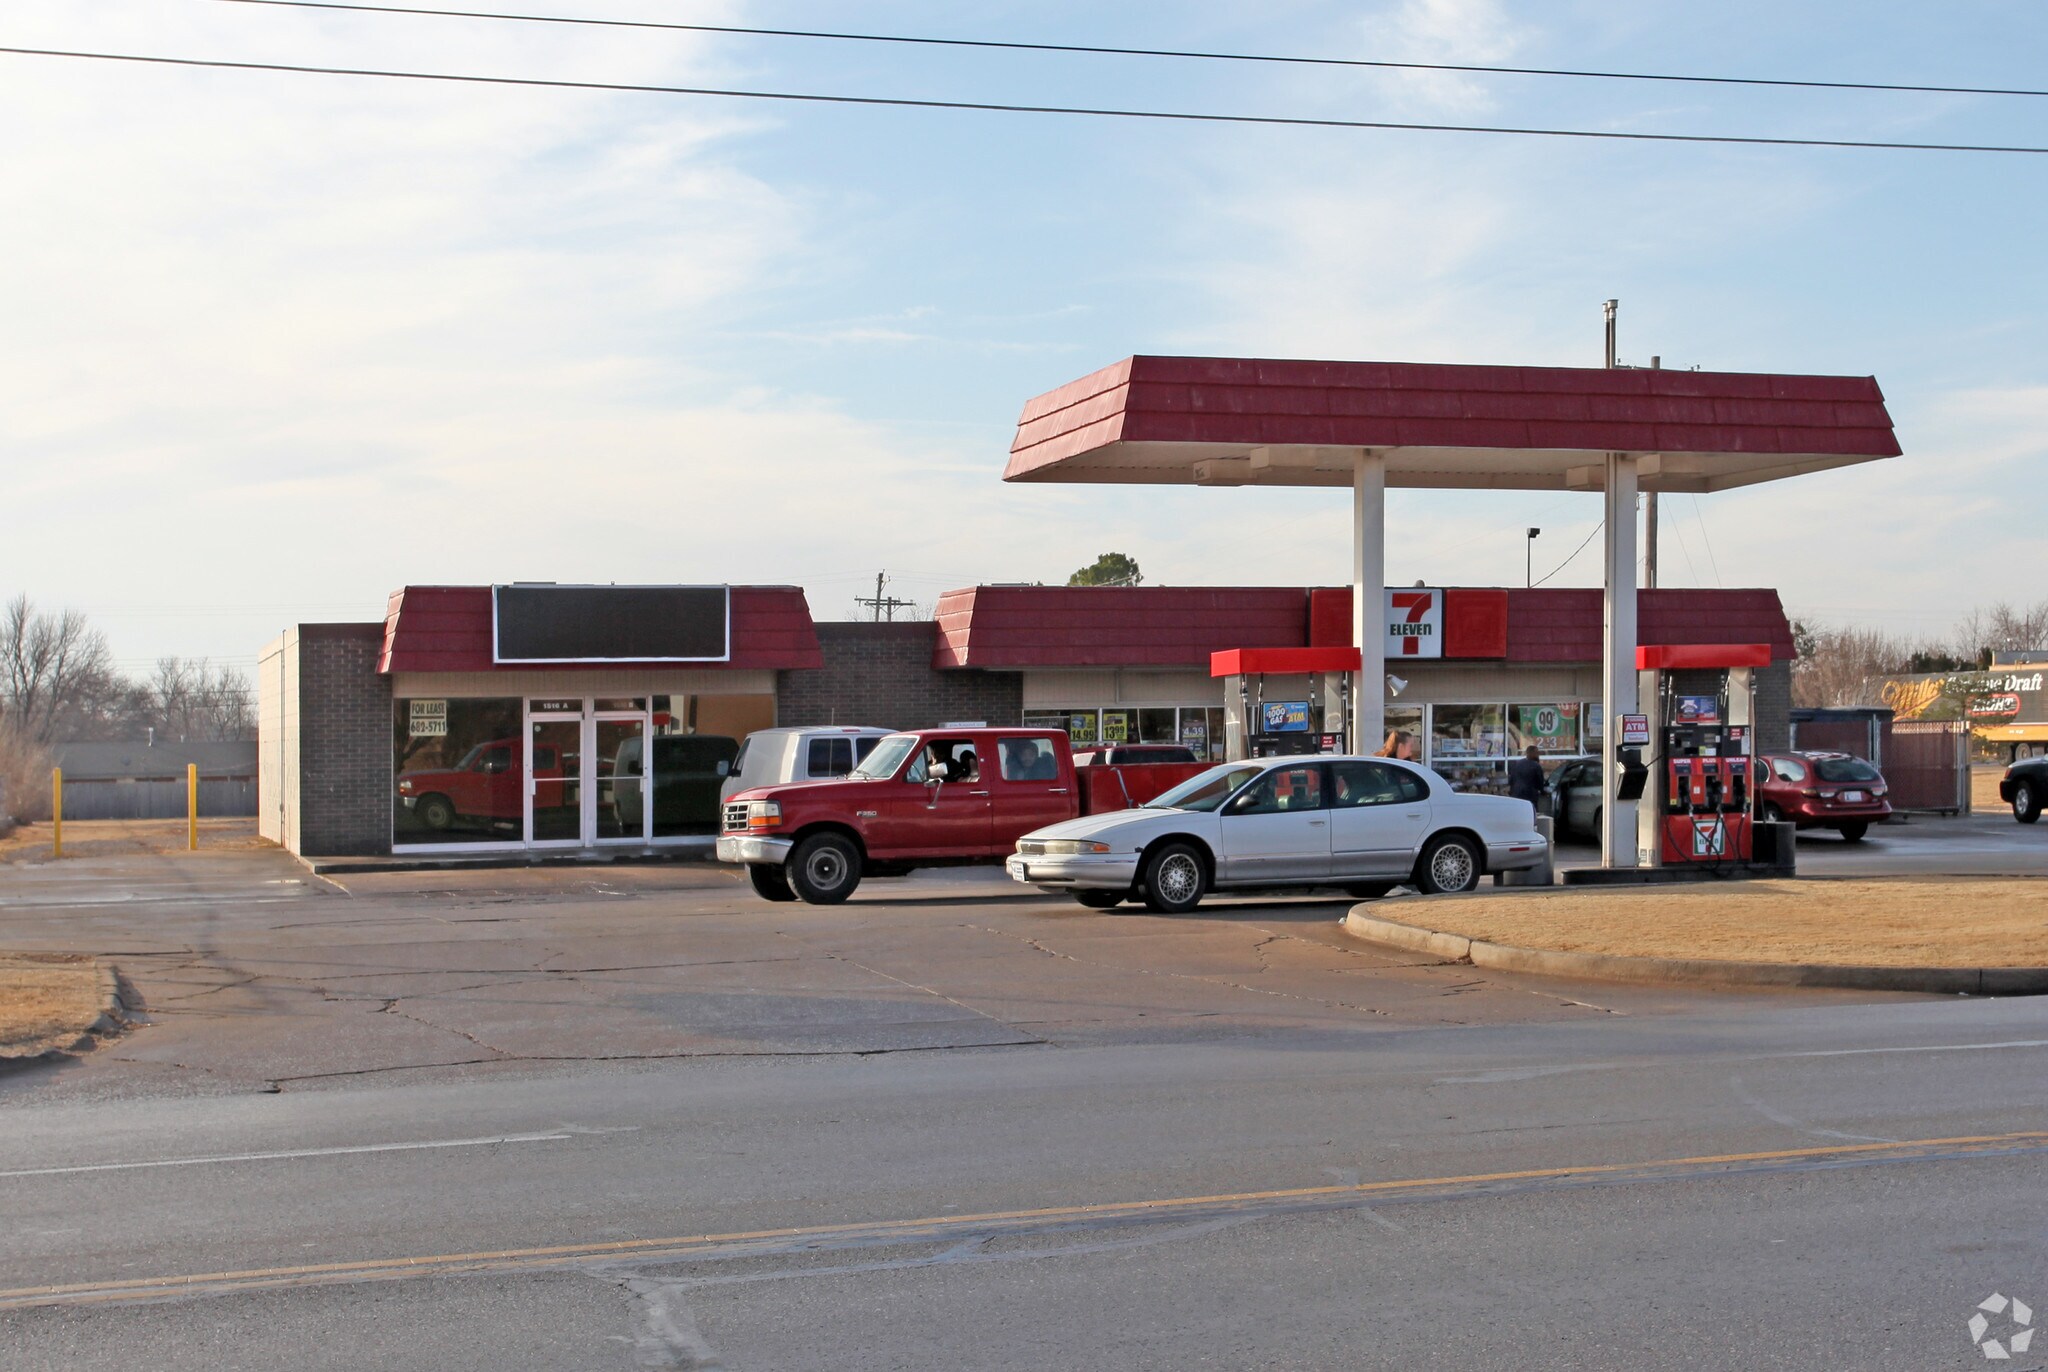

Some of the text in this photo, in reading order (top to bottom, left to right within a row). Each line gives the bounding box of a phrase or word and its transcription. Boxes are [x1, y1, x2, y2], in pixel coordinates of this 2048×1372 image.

[1391, 592, 1432, 655] 7
[2004, 673, 2043, 691] Draft
[411, 703, 445, 715] FOR LEASE
[1270, 716, 1283, 725] GAS
[410, 721, 446, 733] 682-5711
[1625, 723, 1646, 731] ATM
